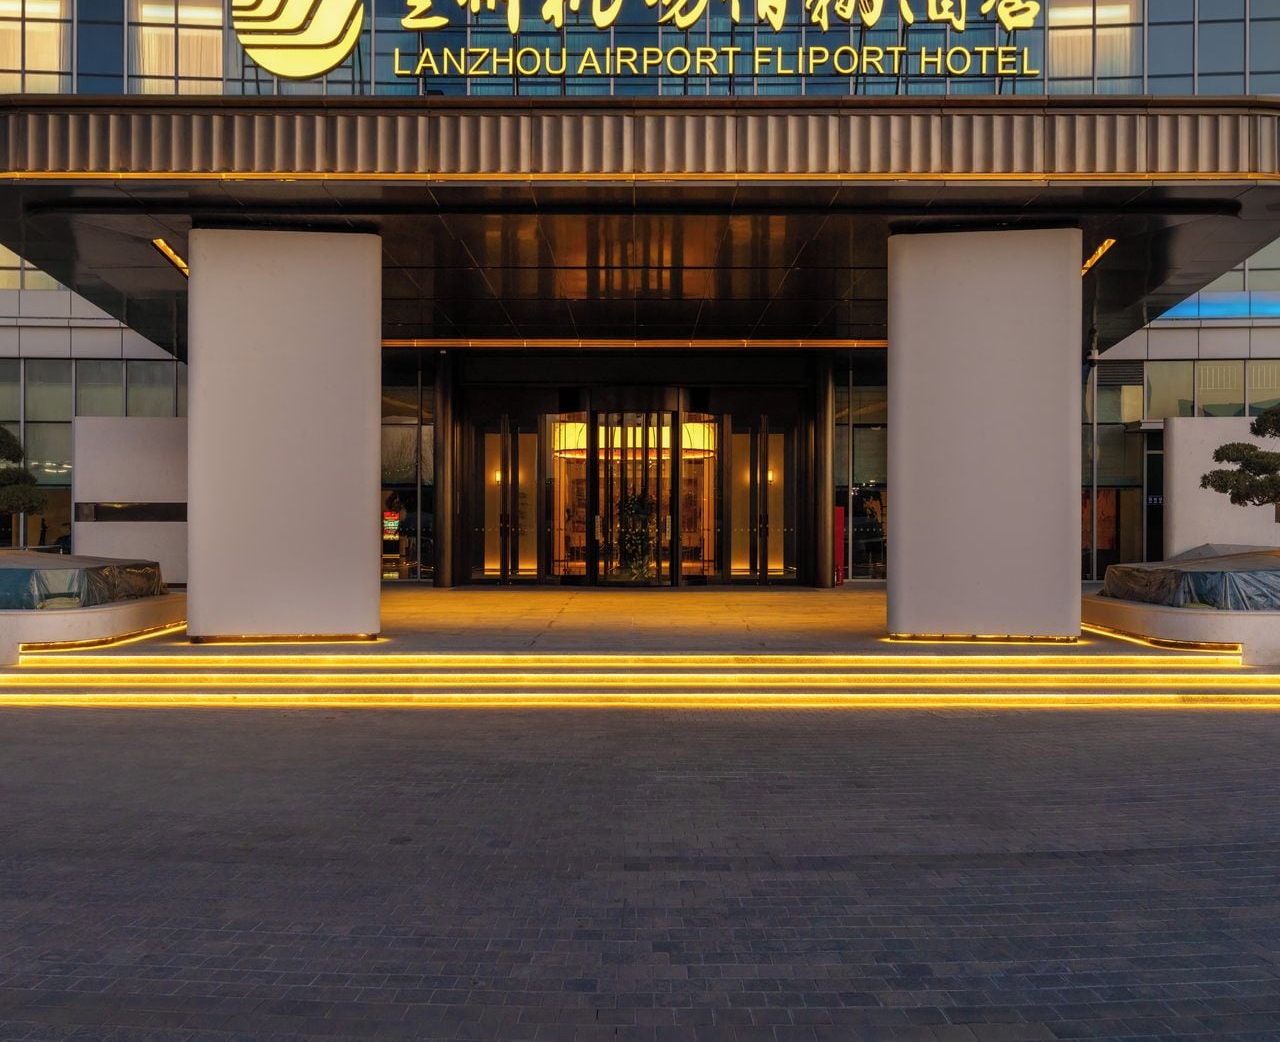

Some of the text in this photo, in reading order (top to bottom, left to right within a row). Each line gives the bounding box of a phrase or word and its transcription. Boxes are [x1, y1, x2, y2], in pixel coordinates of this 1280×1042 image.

[394, 45, 1041, 76] LANZHOU AIRPORT FLIPORT HOTEL
